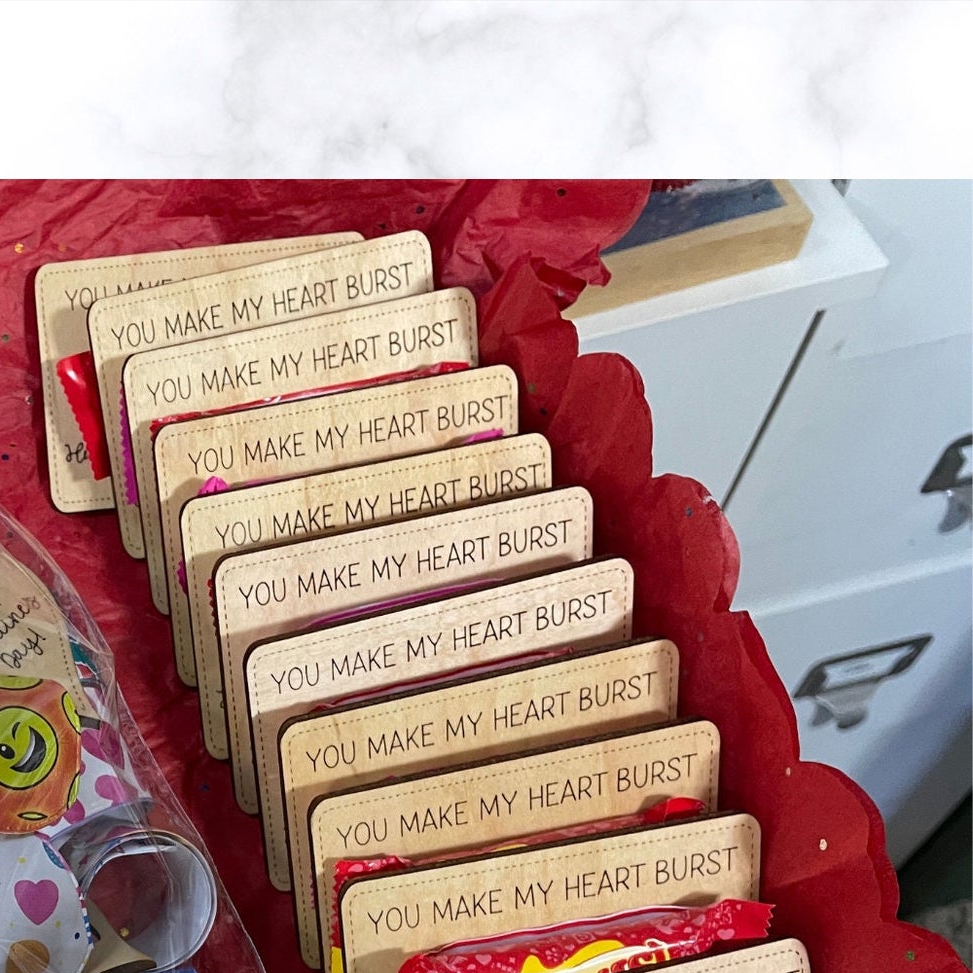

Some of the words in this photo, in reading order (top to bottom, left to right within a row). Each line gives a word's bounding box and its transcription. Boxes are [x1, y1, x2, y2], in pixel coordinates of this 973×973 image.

[112, 319, 155, 349] YOU
[165, 305, 222, 338] MAKE
[233, 296, 265, 325] MY
[274, 280, 338, 315] HEART
[347, 263, 413, 299] BURST
[148, 375, 191, 406] YOU
[202, 361, 260, 395] MAKE
[271, 352, 304, 382] MY
[313, 335, 380, 373] HEART
[389, 319, 458, 356] BURST
[188, 446, 234, 475] YOU
[244, 431, 306, 464] MAKE
[316, 425, 349, 454] MY
[359, 409, 429, 444] HEART
[438, 395, 508, 429] BURST
[216, 518, 263, 548] YOU
[272, 504, 336, 539] MAKE
[346, 495, 380, 525] MY
[389, 479, 462, 515] HEART
[469, 464, 543, 500] BURST
[239, 579, 286, 609] YOU
[298, 562, 361, 599] MAKE
[372, 554, 406, 583] MY
[417, 536, 490, 572] HEART
[498, 519, 573, 557] BURST
[272, 663, 320, 695] YOU
[331, 643, 396, 681] MAKE
[406, 632, 442, 663] MY
[453, 611, 527, 652] HEART
[536, 591, 612, 630] BURST
[306, 741, 357, 773] YOU
[368, 722, 434, 757] MAKE
[446, 712, 483, 744] MY
[493, 692, 570, 729] HEART
[579, 672, 658, 713] BURST
[337, 819, 388, 849] YOU
[400, 799, 469, 837] MAKE
[480, 790, 518, 821] MY
[528, 771, 608, 810] HEART
[616, 753, 698, 793] BURST
[368, 902, 420, 935] YOU
[433, 884, 503, 924] MAKE
[514, 879, 553, 909] MY
[565, 862, 643, 901] HEART
[655, 846, 738, 886] BURST
